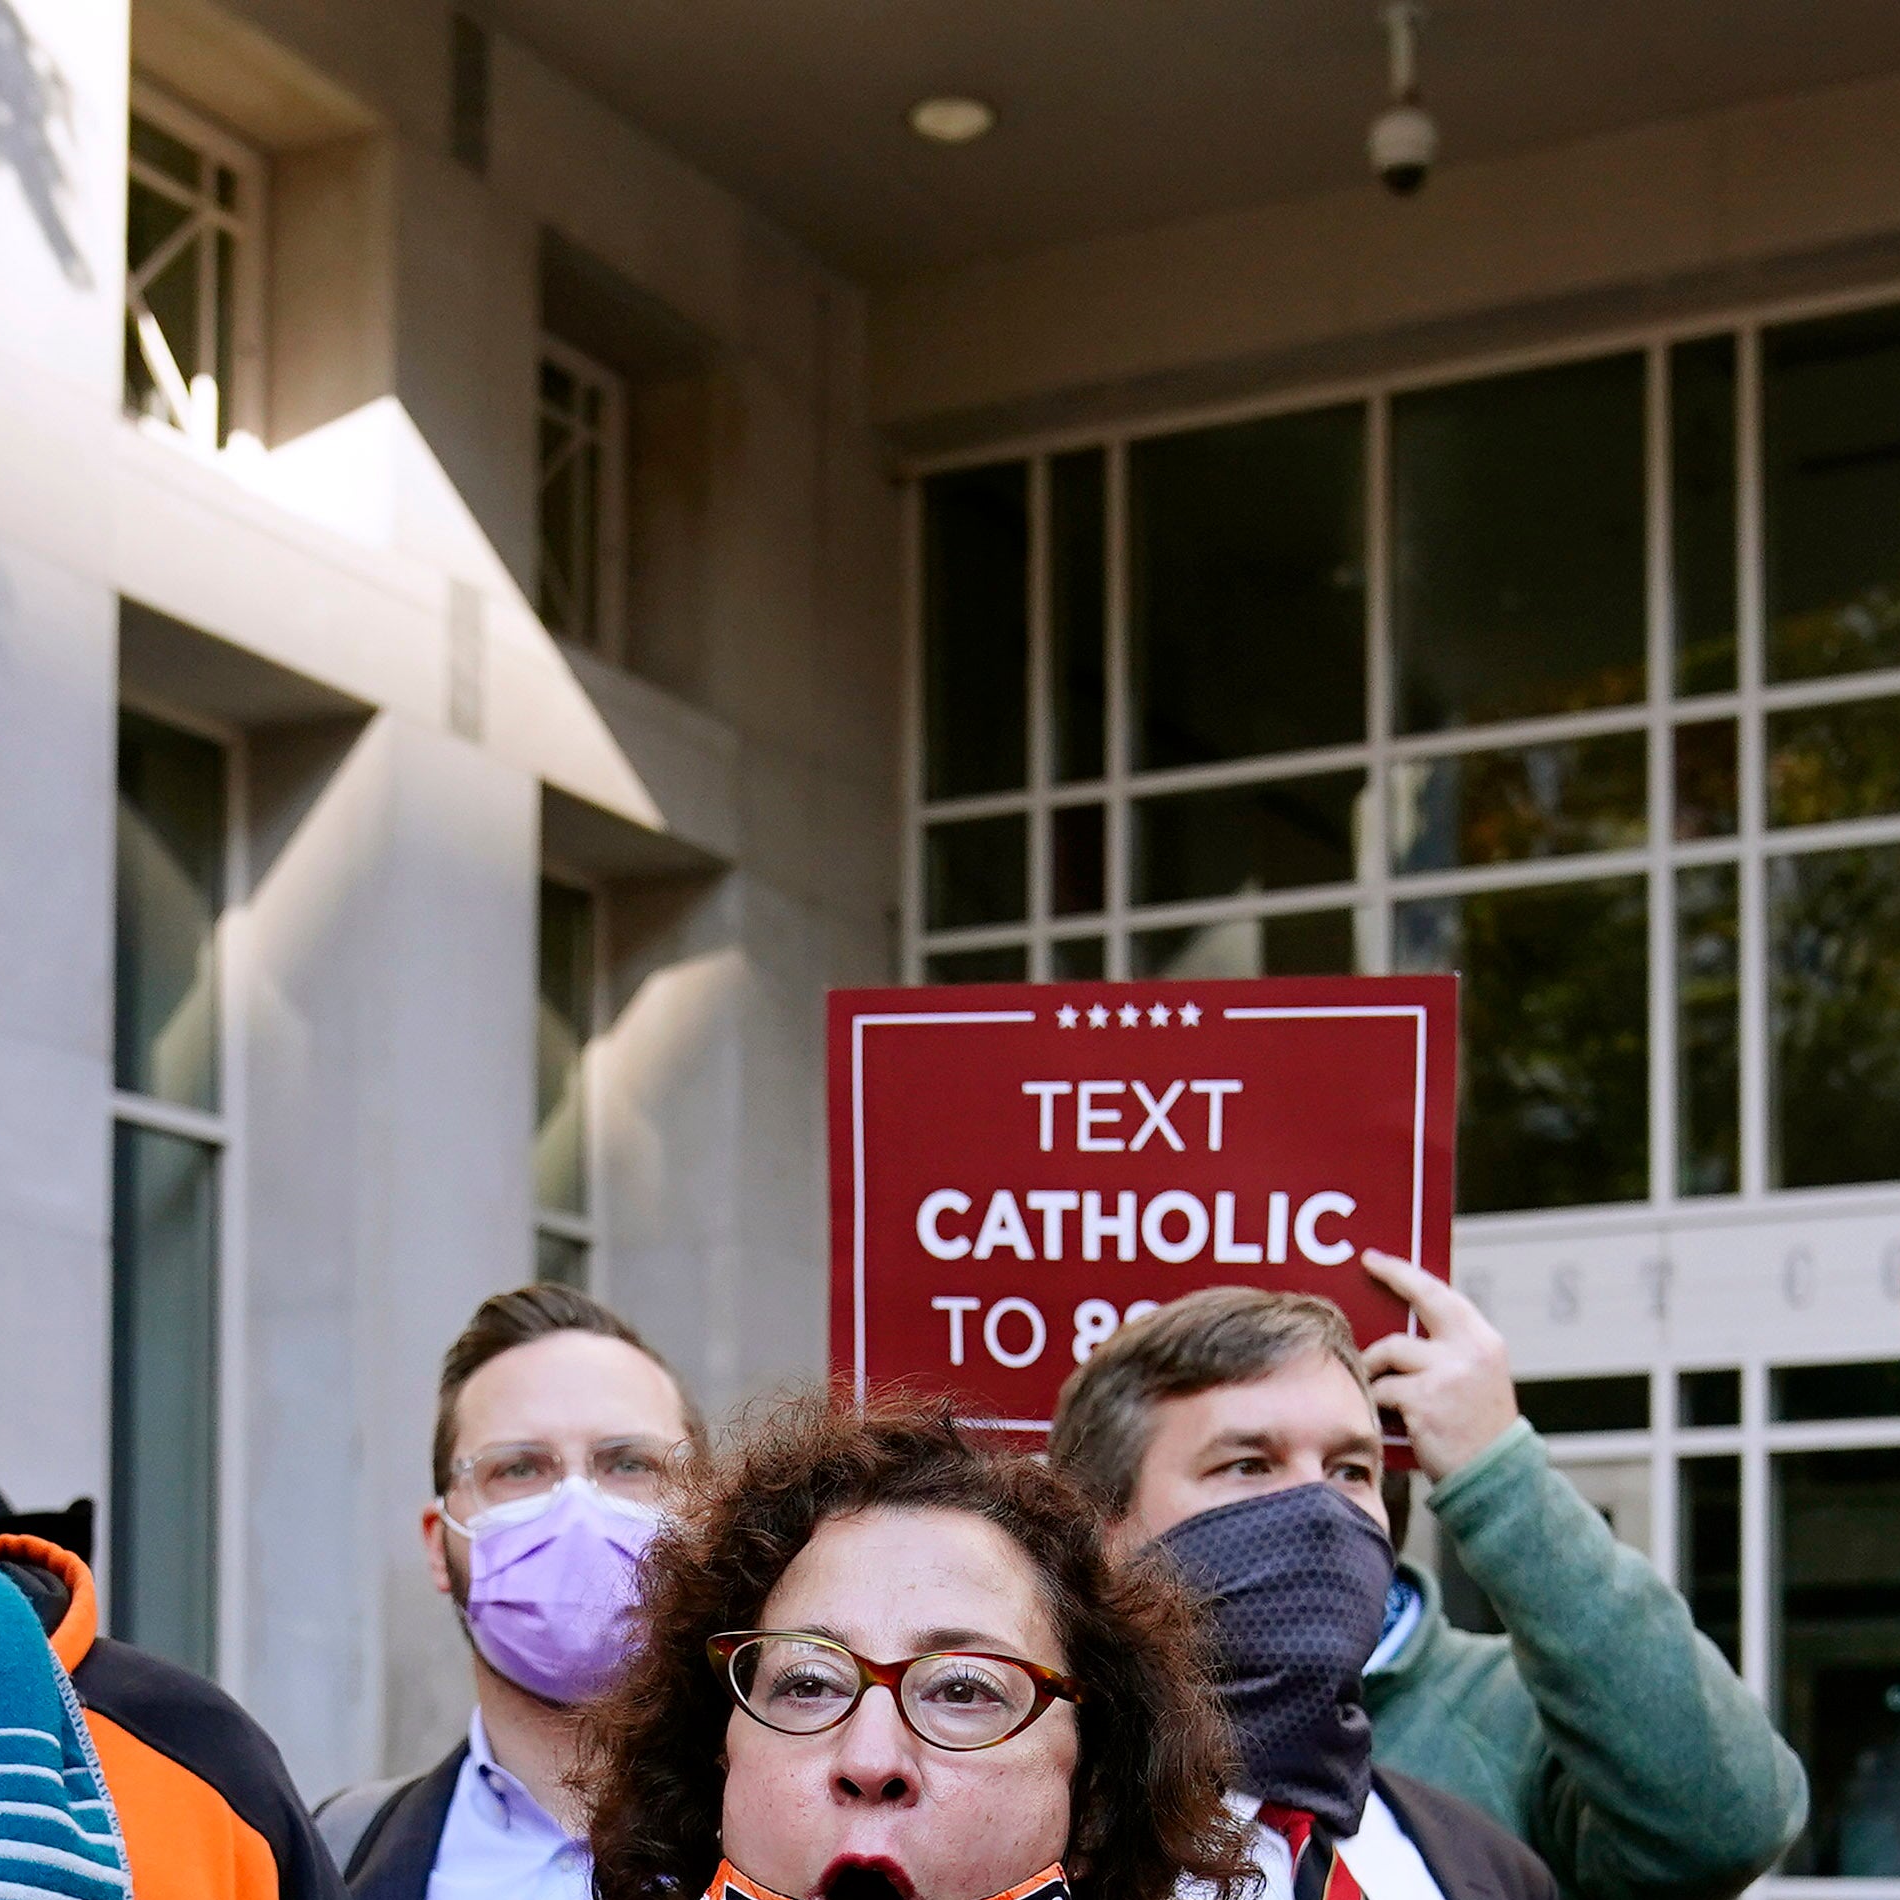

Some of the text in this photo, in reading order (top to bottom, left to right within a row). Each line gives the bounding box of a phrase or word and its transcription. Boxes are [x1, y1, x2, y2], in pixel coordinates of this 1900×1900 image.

[1021, 1078, 1244, 1153] TEXT
[915, 1187, 1357, 1266] CATHOLIC
[930, 1295, 1048, 1369] TO
